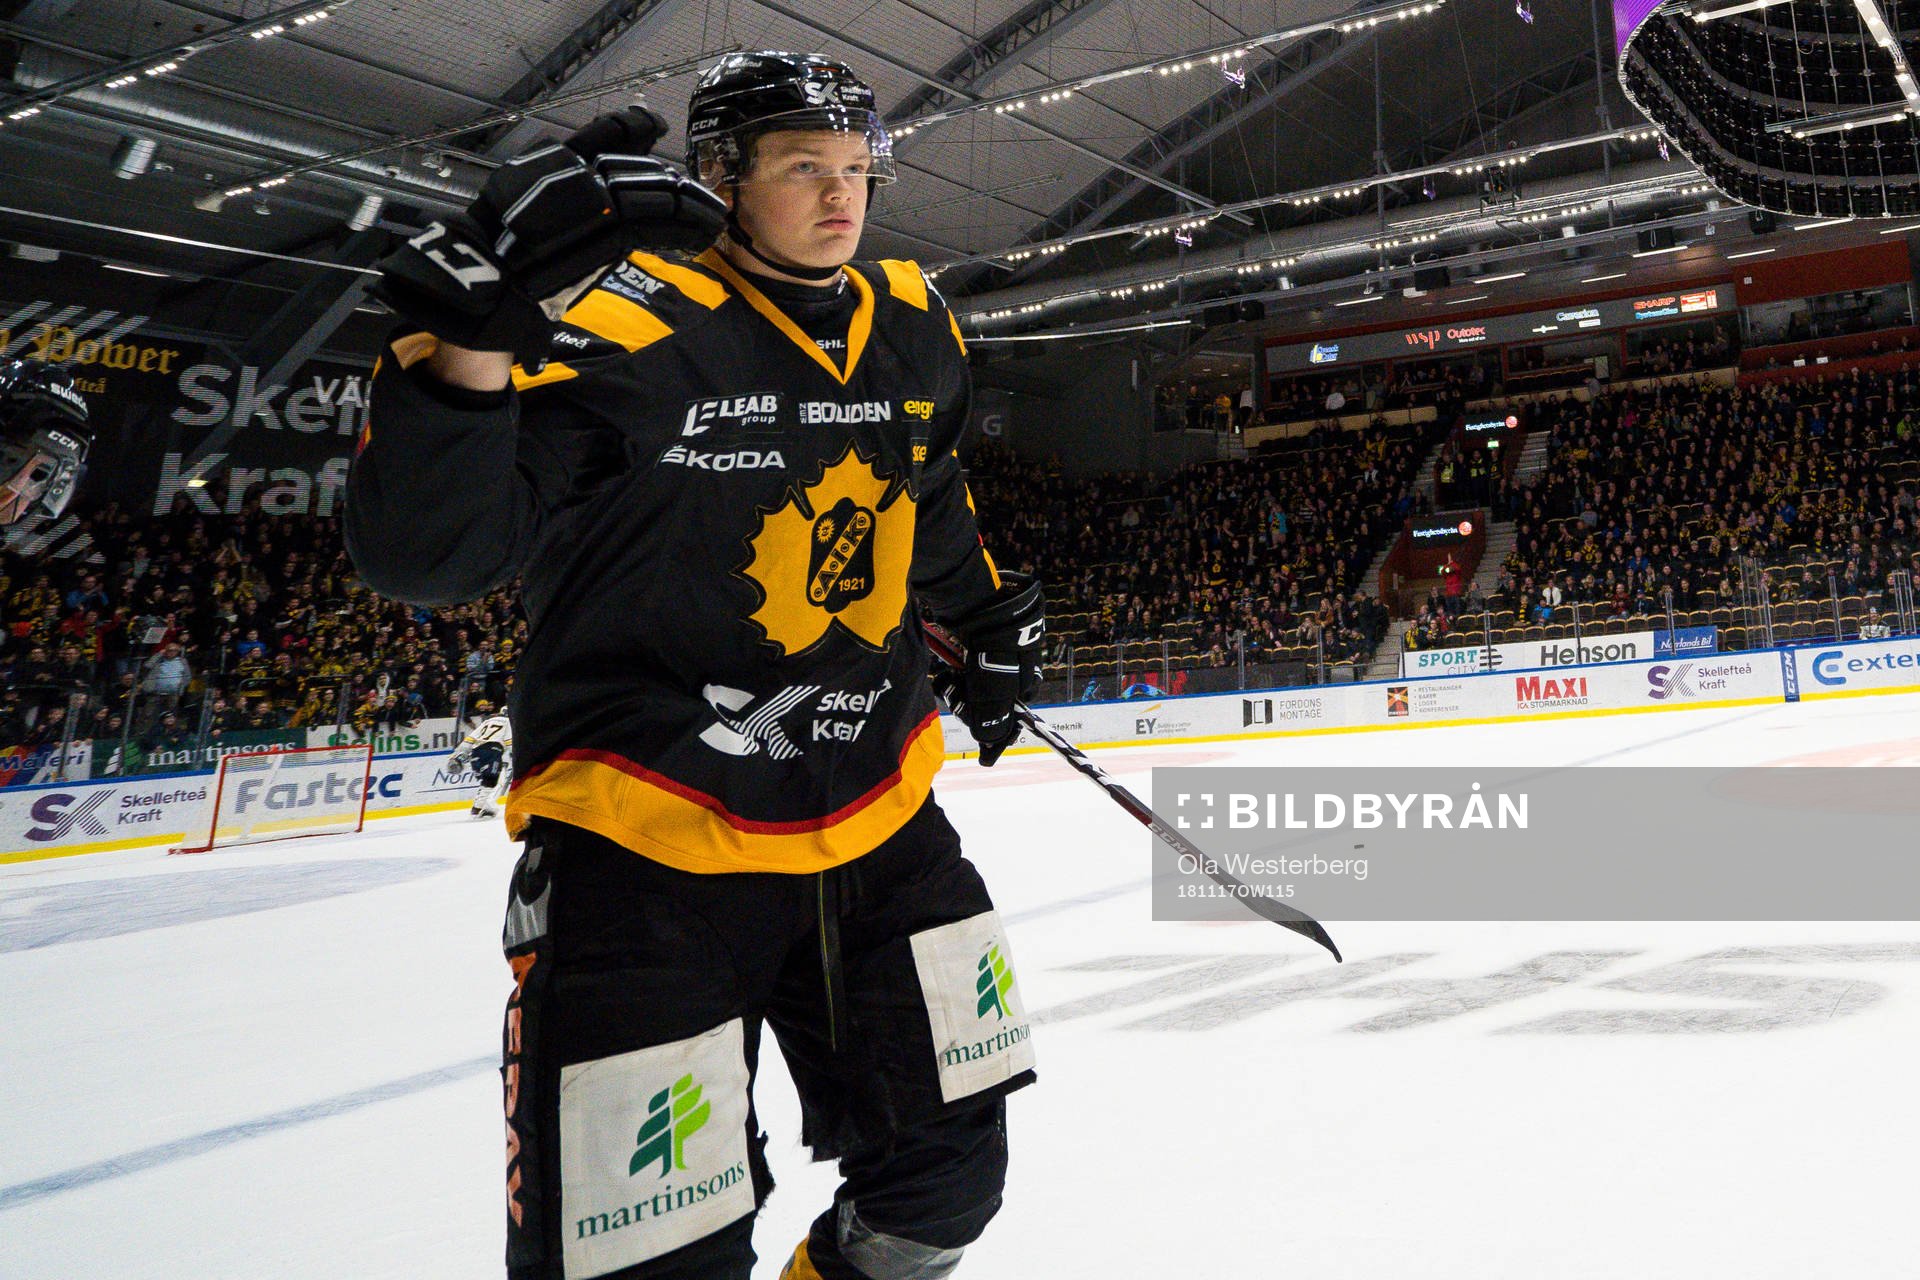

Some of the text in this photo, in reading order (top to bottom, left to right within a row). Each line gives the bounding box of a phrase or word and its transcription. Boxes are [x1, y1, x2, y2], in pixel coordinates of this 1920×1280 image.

[691, 116, 719, 130] CCM
[1633, 296, 1676, 310] SHARP
[25, 322, 182, 375] Power
[312, 374, 369, 409] VÄ
[719, 395, 778, 417] LEAB
[741, 413, 776, 426] group
[660, 444, 786, 472] ŠKODA
[838, 577, 865, 592] 1921
[1418, 649, 1478, 668] SPORT
[1540, 641, 1637, 666] Henson
[1697, 662, 1752, 678] Skellefteå
[1515, 675, 1588, 702] MAXI
[1699, 679, 1726, 690] Kraft
[1279, 698, 1323, 710] FORDONS
[1530, 698, 1588, 709] STORMARKNAD
[1279, 709, 1323, 721] MONTAGE
[1135, 717, 1158, 735] EY
[120, 786, 208, 809] Skellefteå
[234, 770, 404, 815] Fastec
[117, 809, 163, 825] Kraft
[576, 1160, 746, 1240] martinsons
